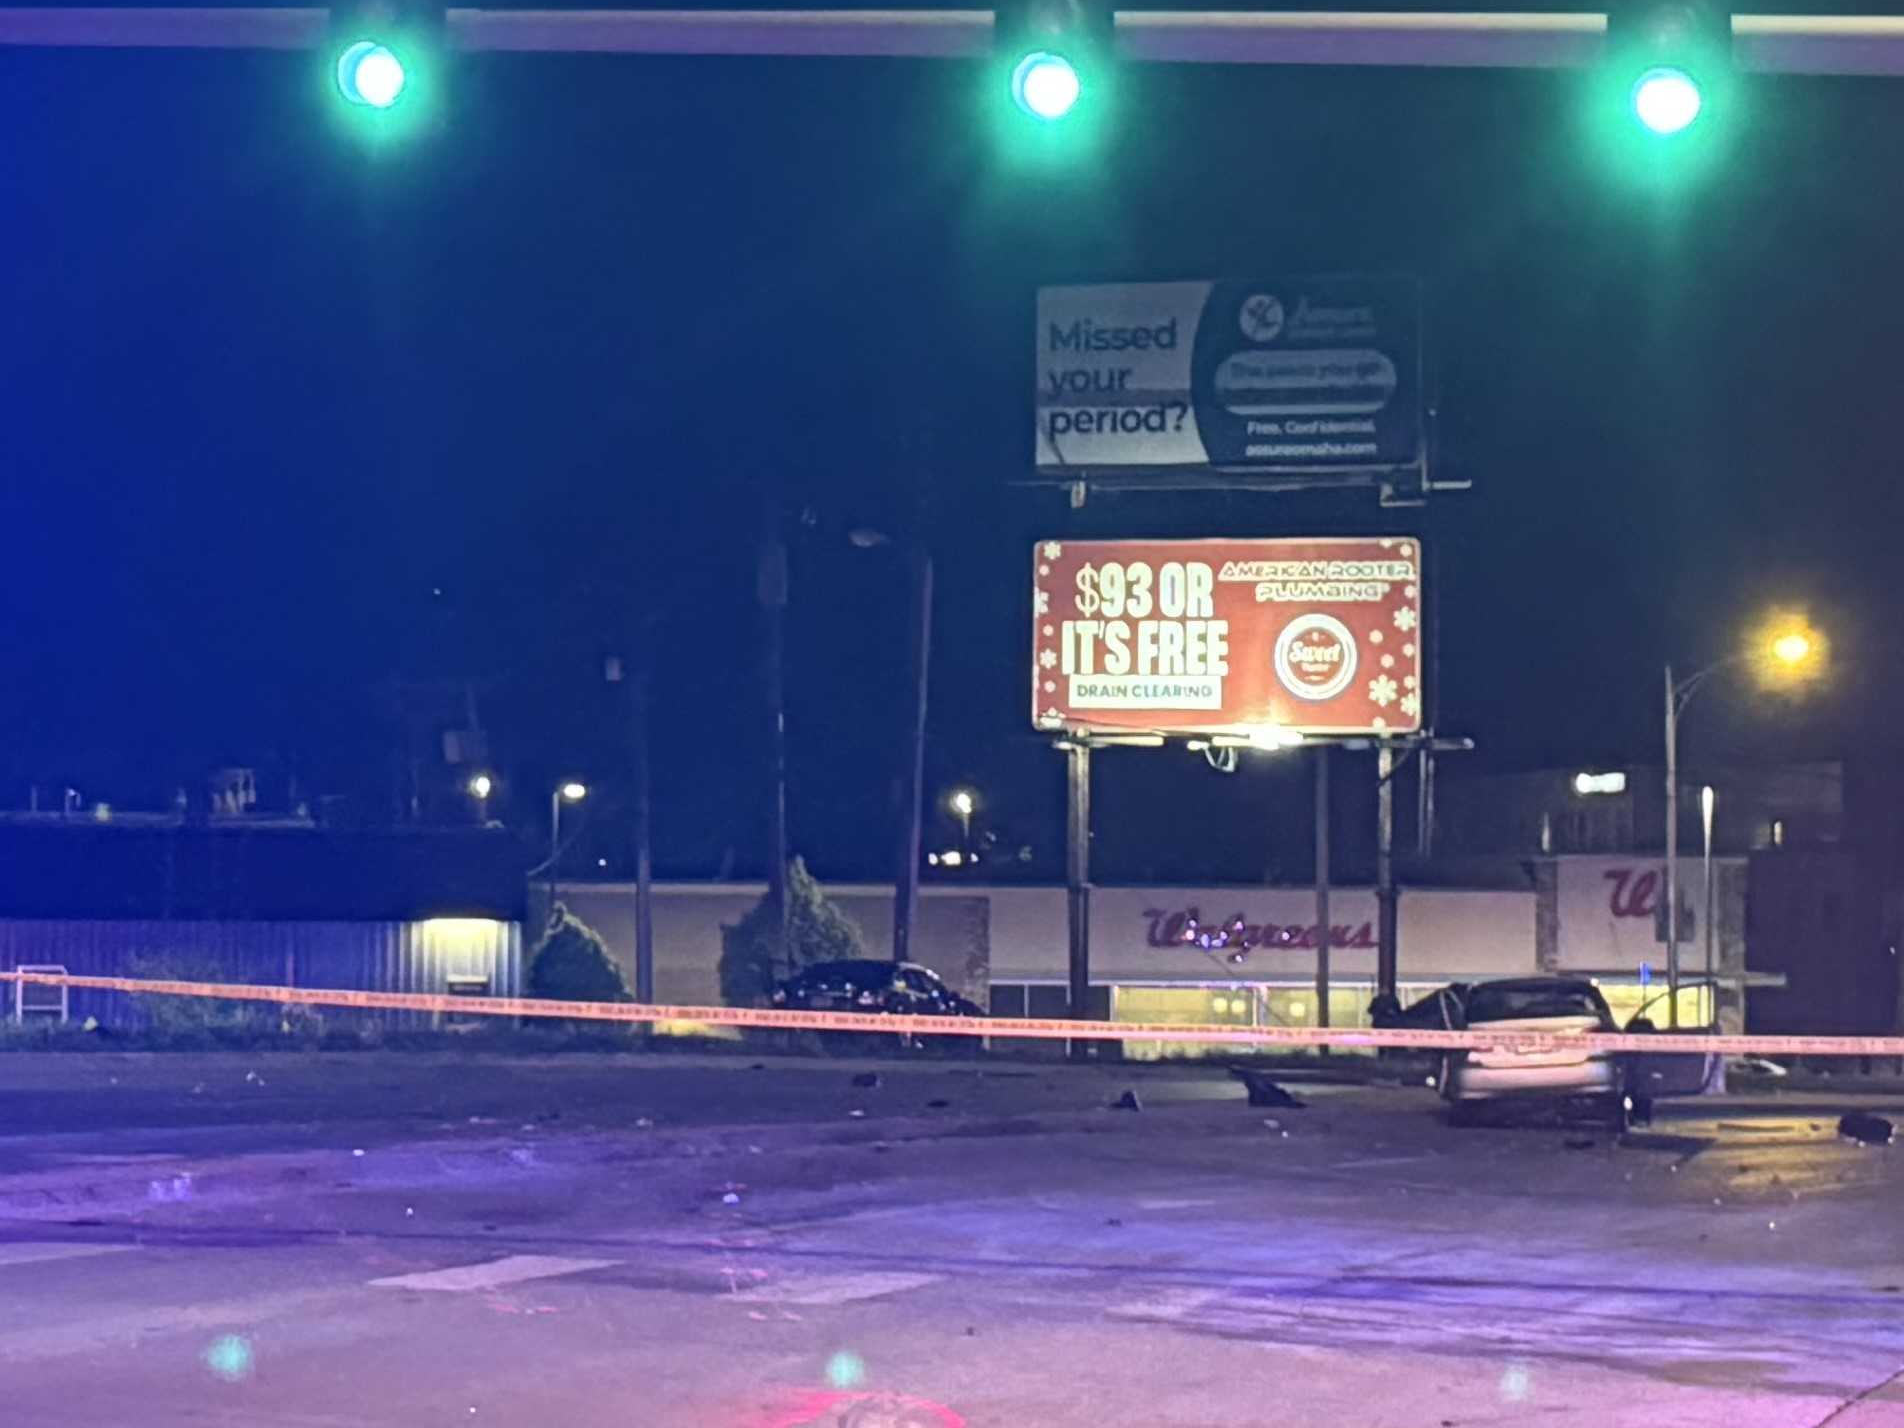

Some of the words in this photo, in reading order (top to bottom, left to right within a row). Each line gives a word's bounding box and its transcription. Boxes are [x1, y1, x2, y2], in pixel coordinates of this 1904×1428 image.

[1048, 317, 1178, 353] Missed
[1048, 367, 1134, 396] your
[1048, 401, 1189, 439] period?
[1219, 562, 1327, 580] AMERICAN
[1329, 562, 1415, 580] ROOTER
[1074, 560, 1153, 619] $93
[1159, 560, 1215, 619] OR
[1258, 583, 1382, 601] PLUMBING
[1061, 620, 1132, 675] IT'S
[1138, 620, 1230, 676] FREE
[1076, 684, 1128, 698] DRAIN
